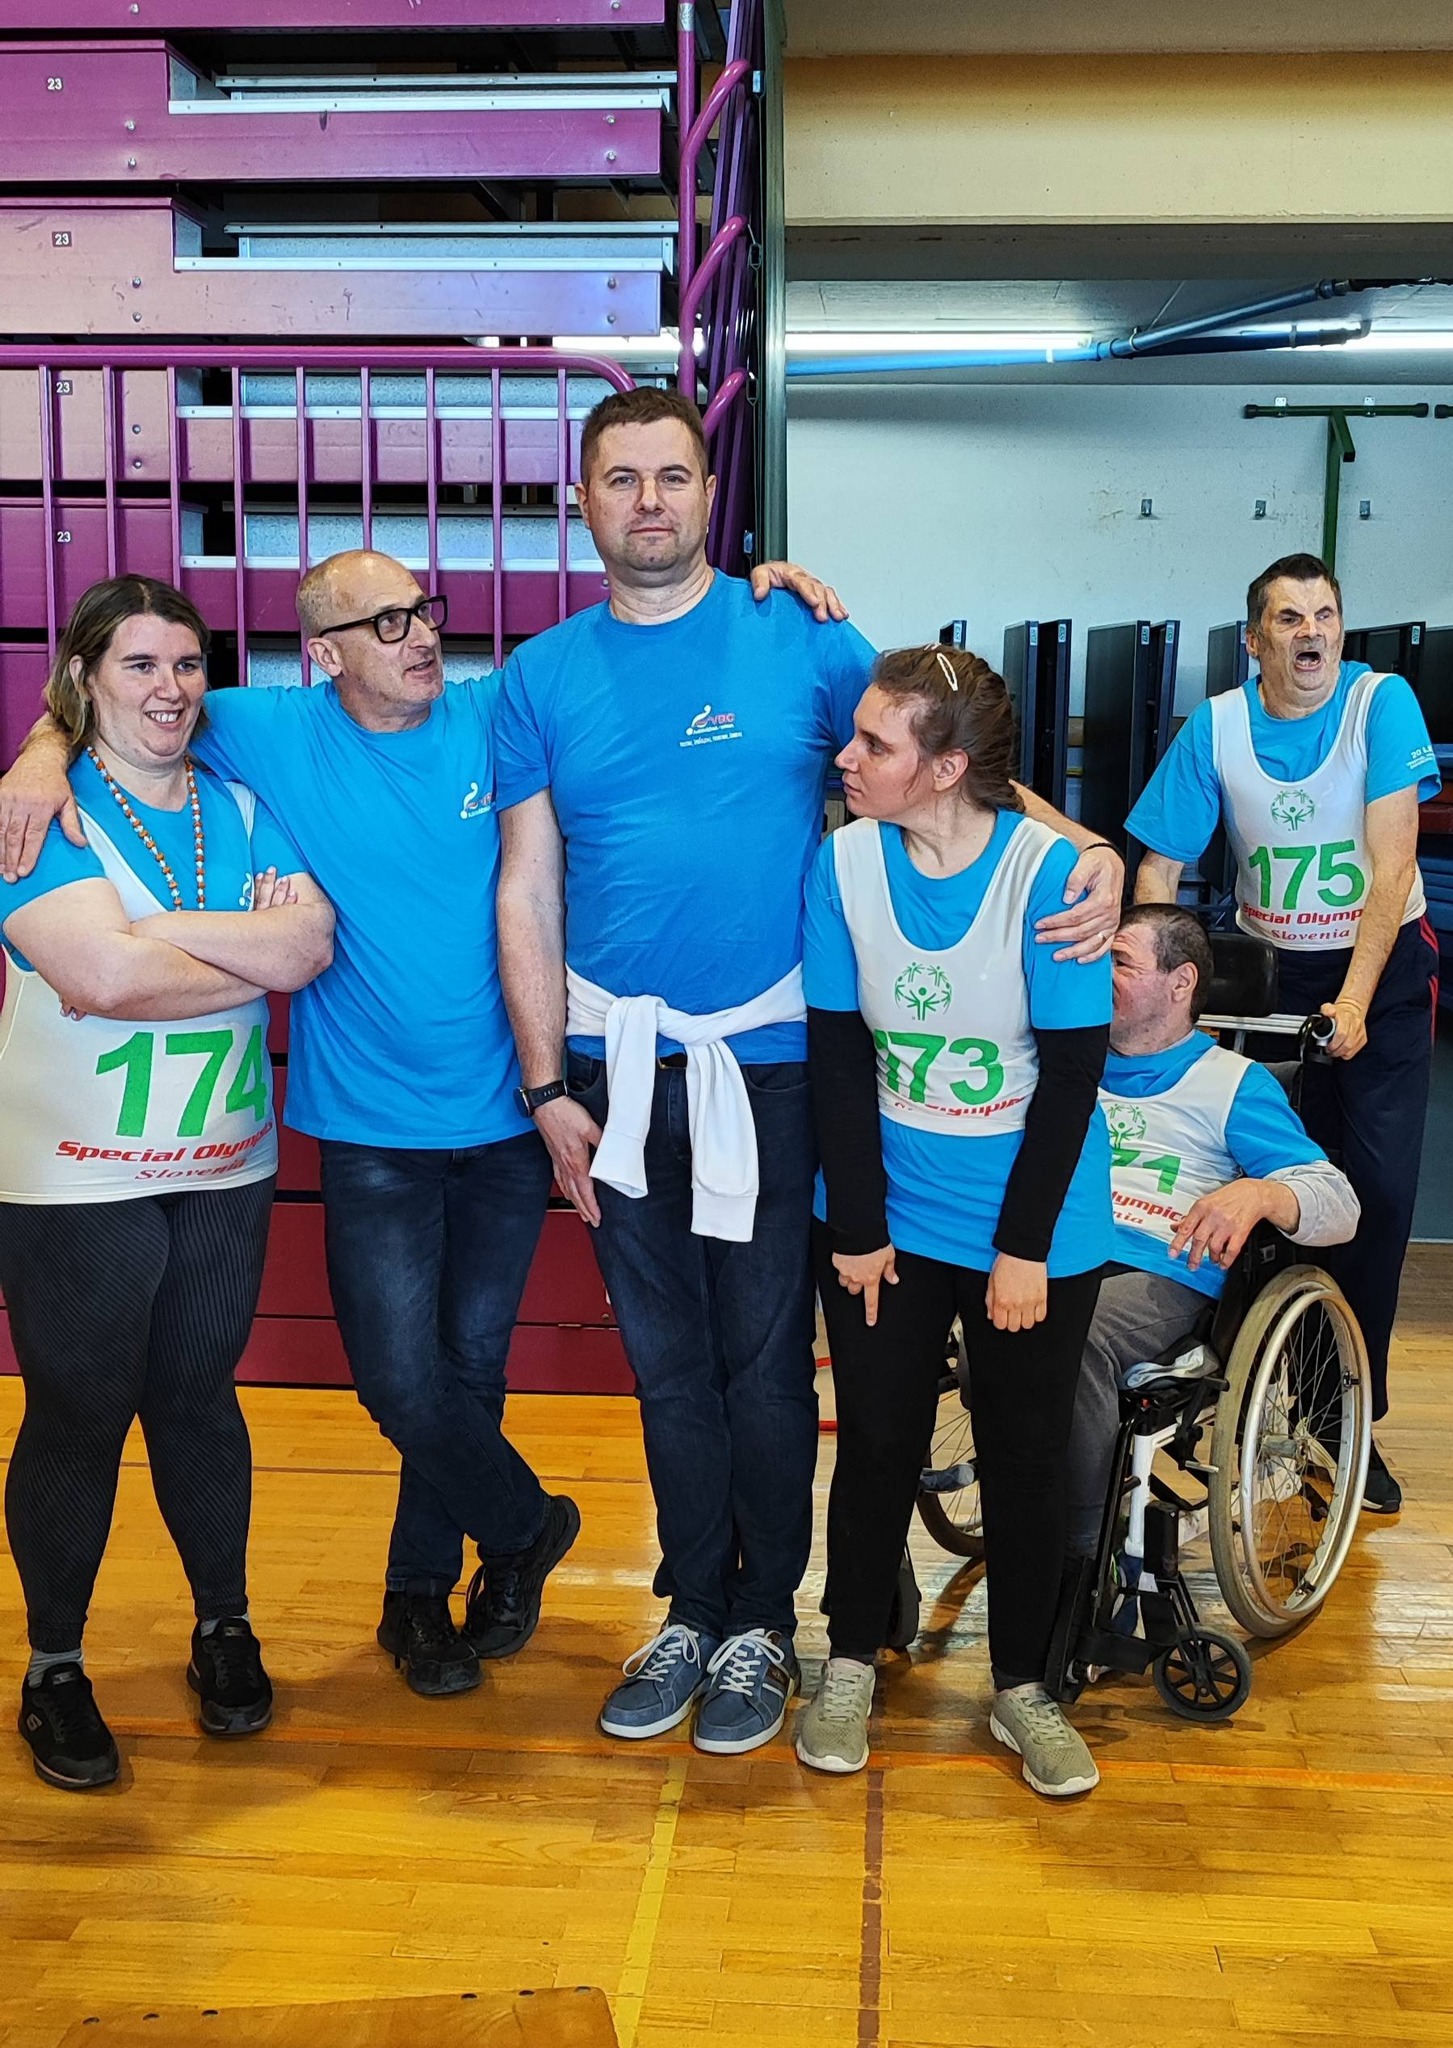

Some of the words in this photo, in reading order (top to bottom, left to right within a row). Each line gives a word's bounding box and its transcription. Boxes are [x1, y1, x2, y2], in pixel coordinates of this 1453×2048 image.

[47, 77, 63, 90] 23
[55, 233, 69, 245] 23
[56, 381, 71, 394] 23
[57, 531, 71, 543] 23
[1248, 838, 1365, 910] 175
[1242, 902, 1292, 925] Special
[1296, 908, 1364, 926] Olymp
[1271, 928, 1351, 941] Slovenia
[873, 1029, 1005, 1106] 173
[96, 1024, 268, 1138] 174
[55, 1140, 187, 1163] Special
[134, 1158, 248, 1181] Slovenia
[1112, 1190, 1187, 1223] lympic
